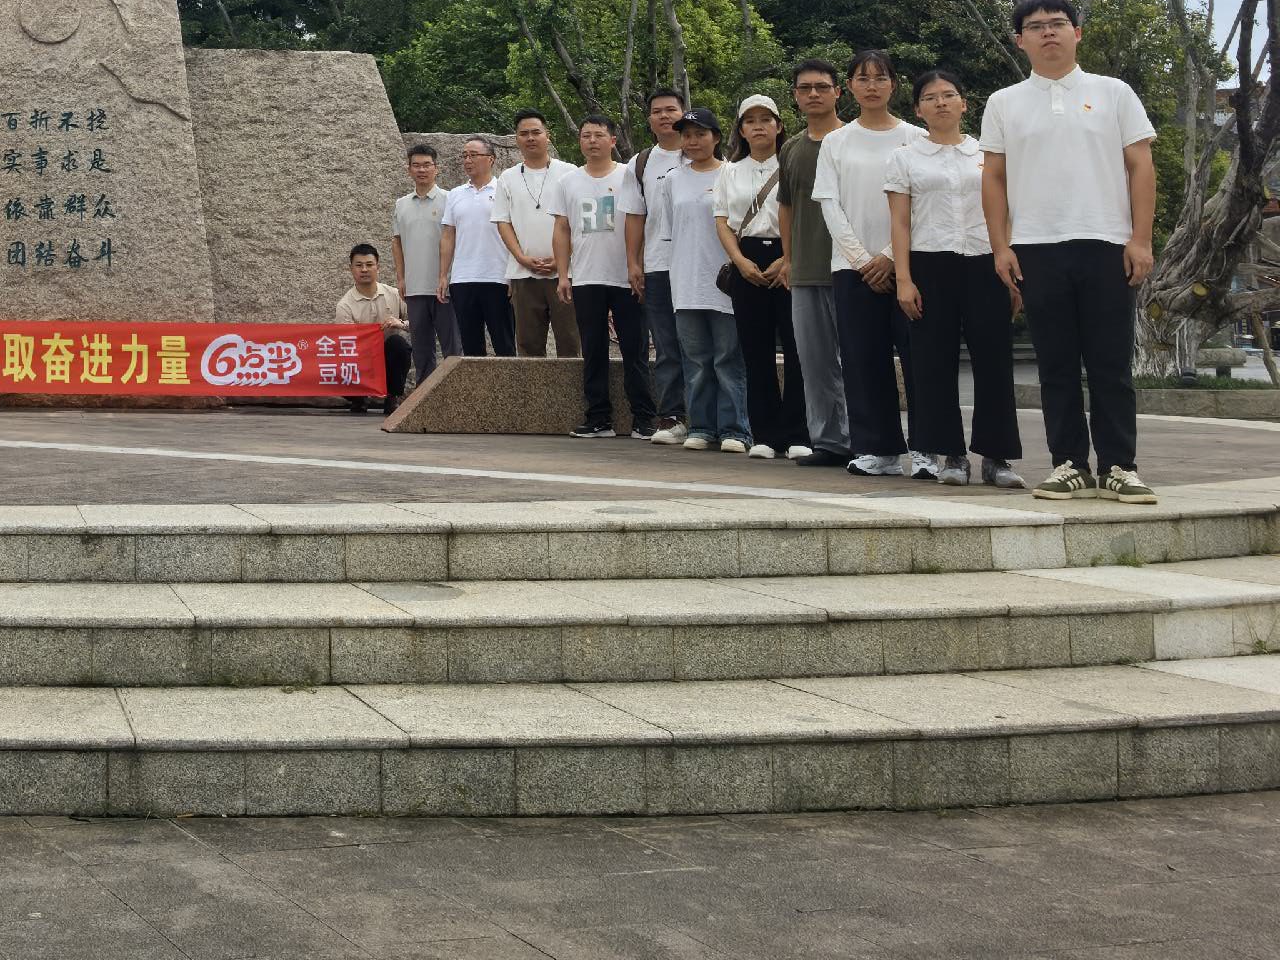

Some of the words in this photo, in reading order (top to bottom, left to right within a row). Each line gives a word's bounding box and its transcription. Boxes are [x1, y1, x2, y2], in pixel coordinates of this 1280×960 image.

[1, 147, 111, 176] 实事求是
[4, 193, 116, 221] 依靠群众
[7, 238, 117, 268] 团结奋斗
[316, 335, 359, 357] 全豆
[318, 362, 361, 386] 豆奶
